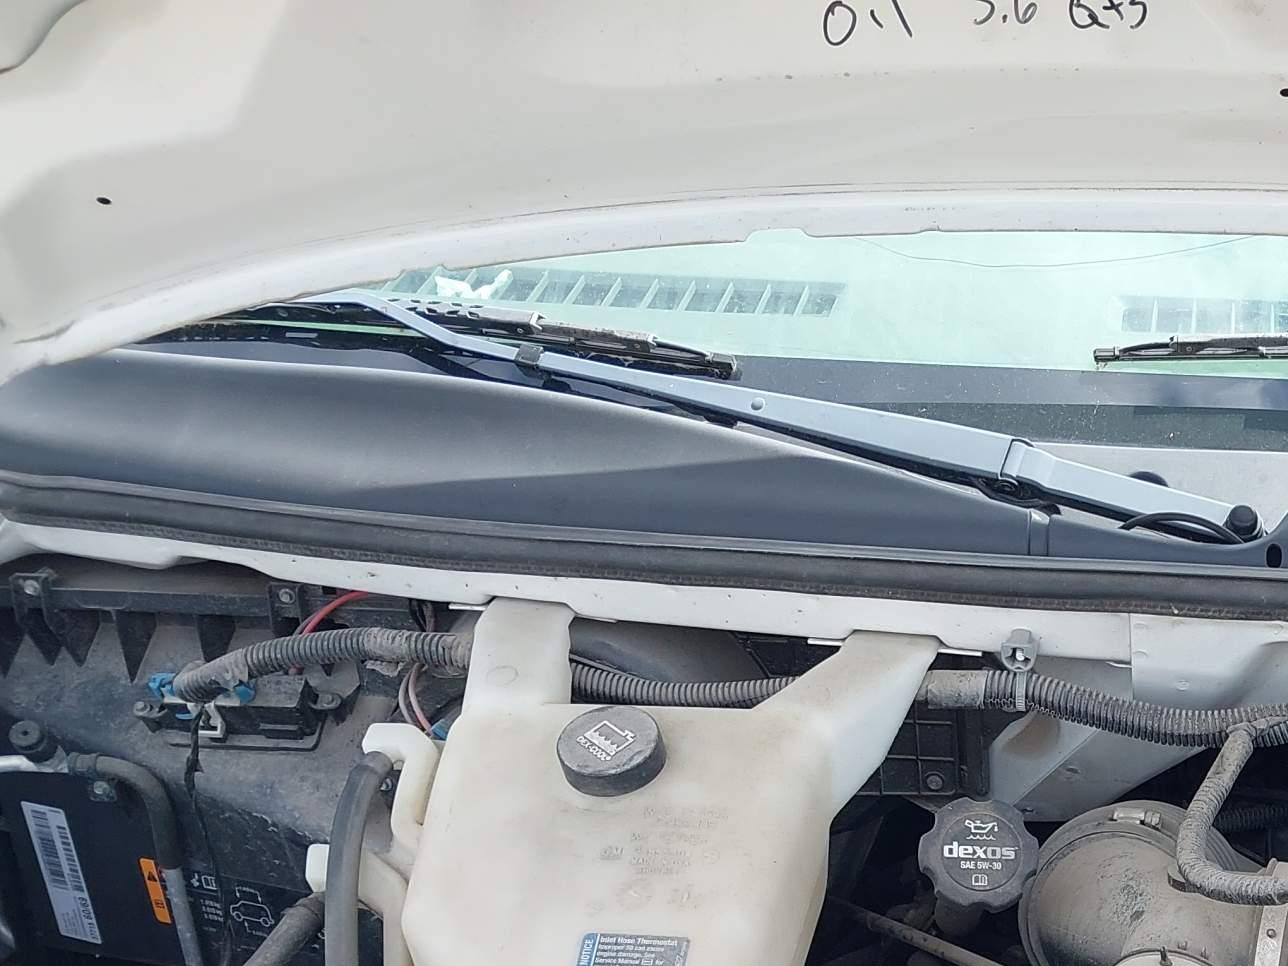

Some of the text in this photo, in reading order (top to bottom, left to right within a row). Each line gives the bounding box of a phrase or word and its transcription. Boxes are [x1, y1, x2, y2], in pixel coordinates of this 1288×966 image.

[823, 0, 913, 46] Oil
[943, 841, 1017, 860] dexos
[960, 861, 1002, 870] SAE 5W-30
[637, 938, 678, 947] Thermostat
[580, 939, 594, 966] NOTICE
